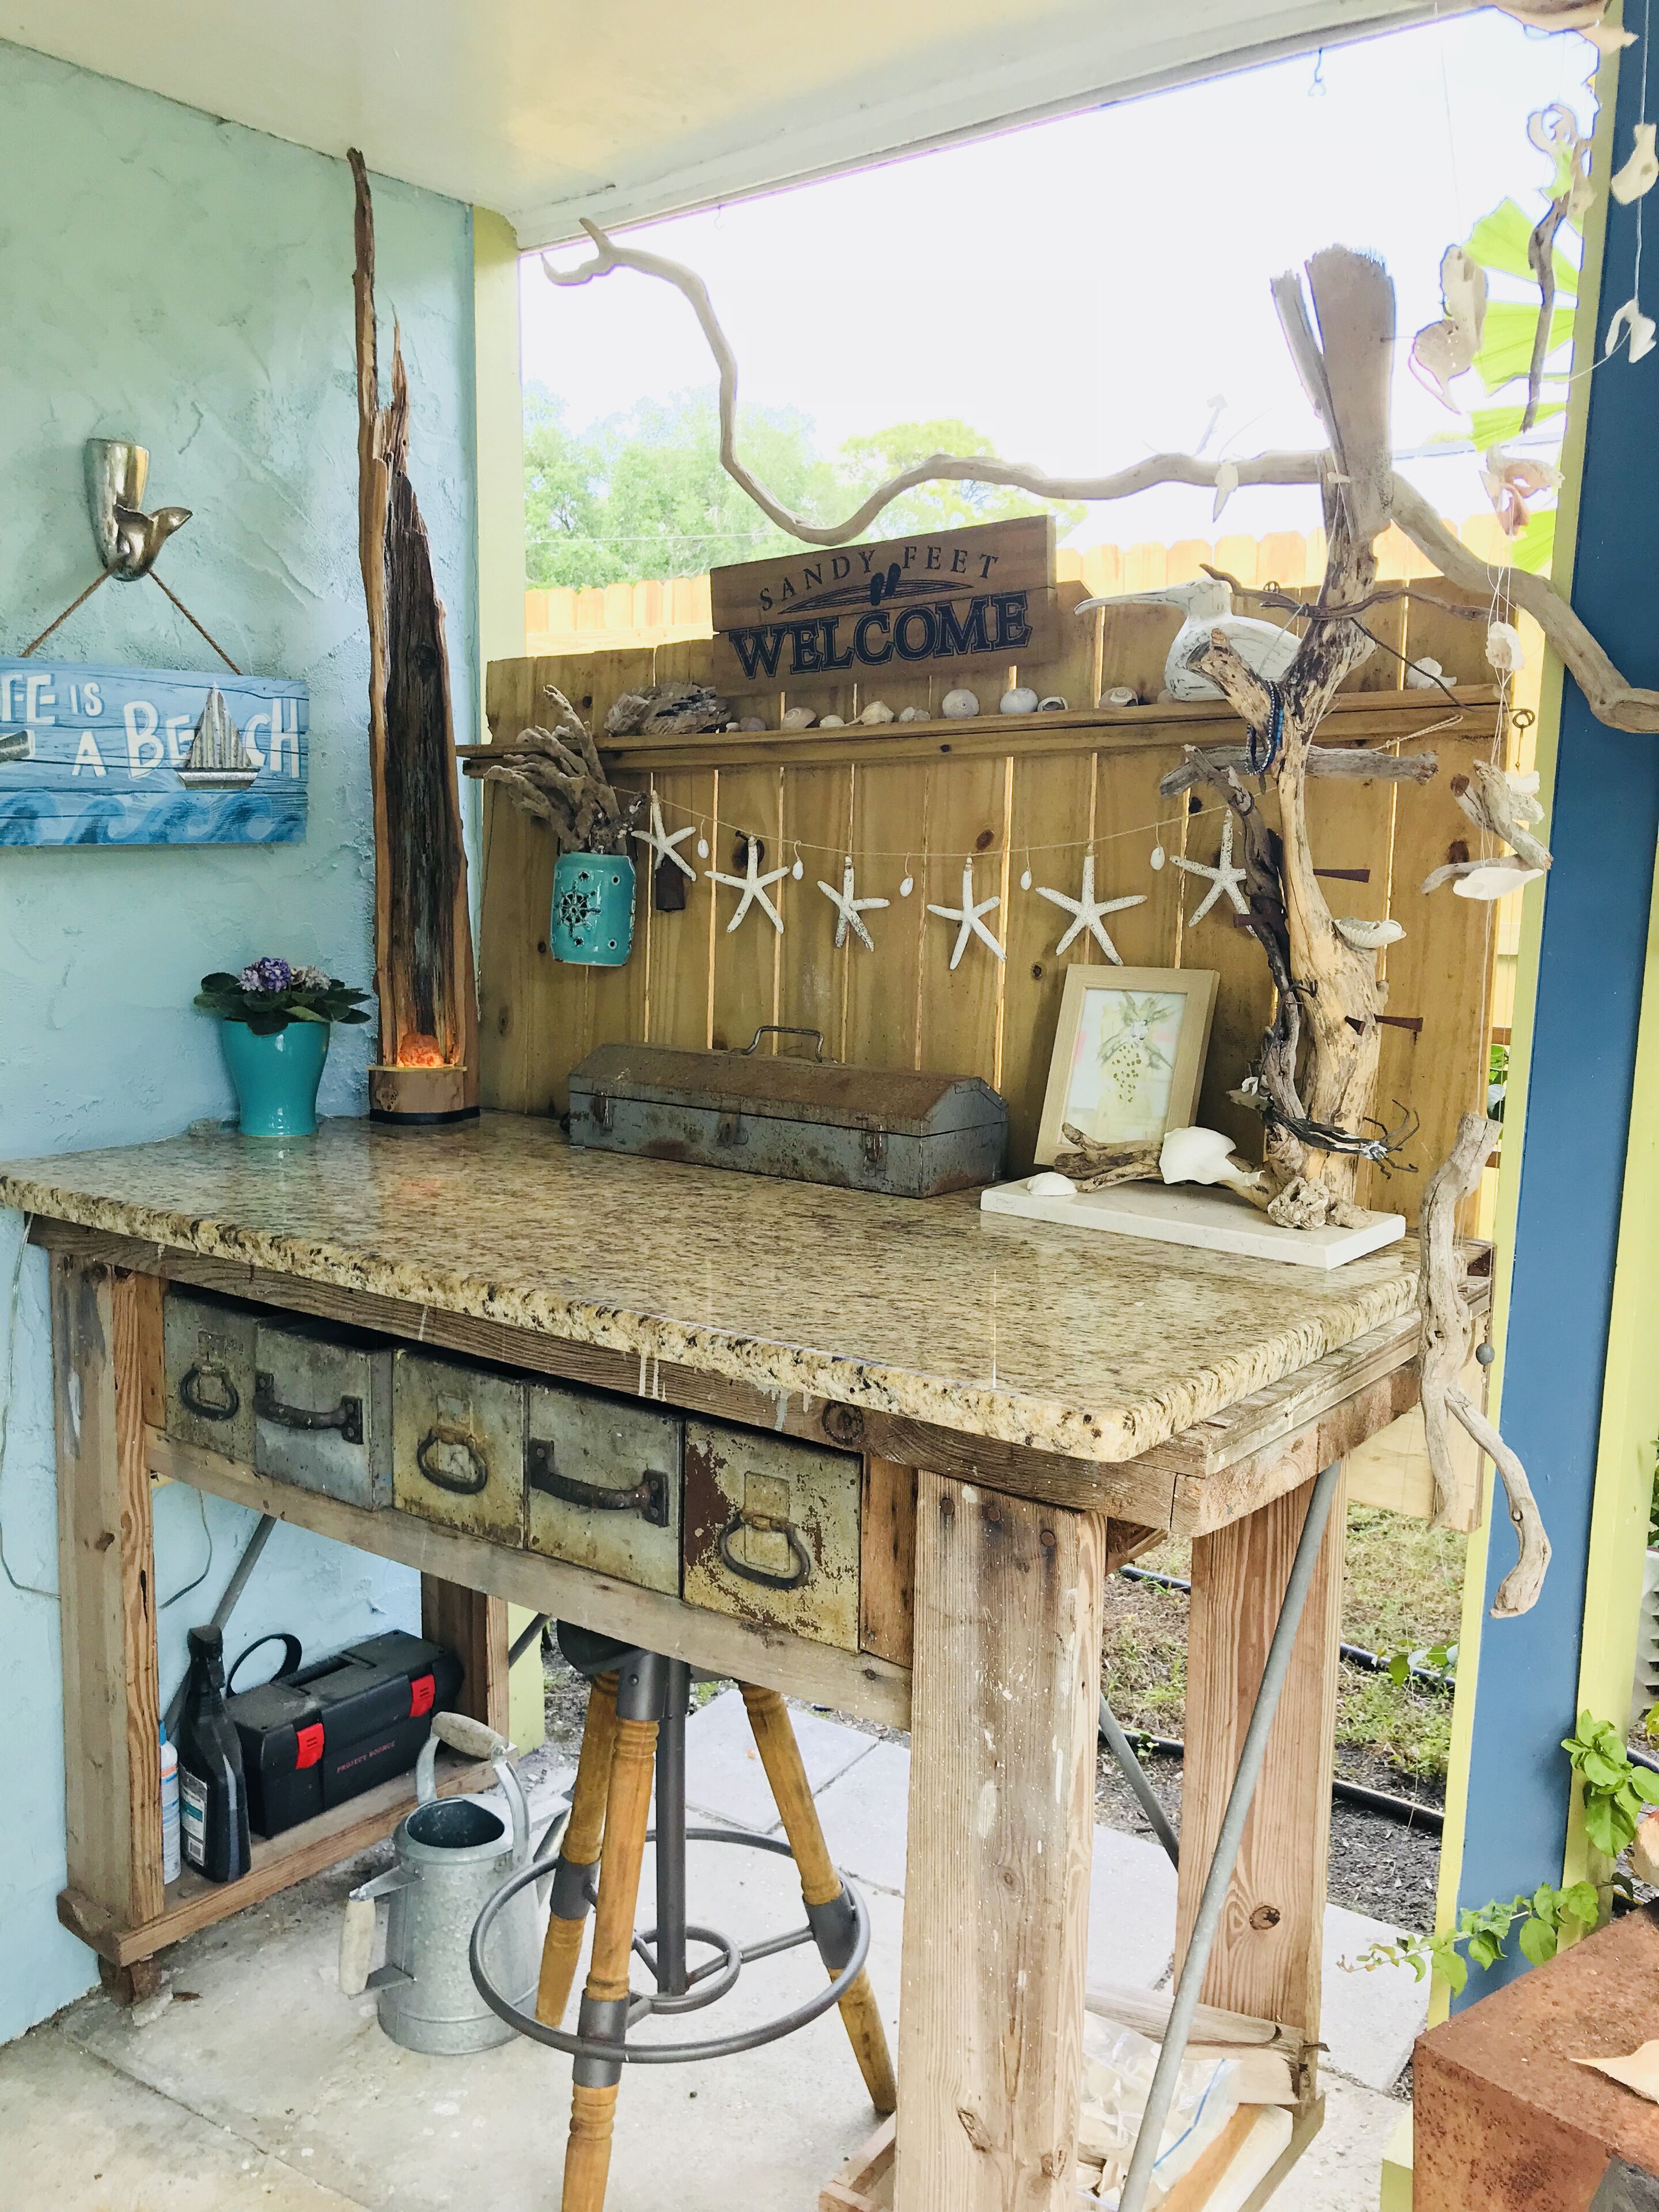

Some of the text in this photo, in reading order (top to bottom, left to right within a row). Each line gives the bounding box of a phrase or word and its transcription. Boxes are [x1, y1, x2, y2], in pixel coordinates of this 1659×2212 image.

[759, 546, 999, 611] SANDY FEET
[729, 590, 1033, 680] WELCOME
[70, 681, 104, 717] IS
[71, 697, 301, 779] A BECH
